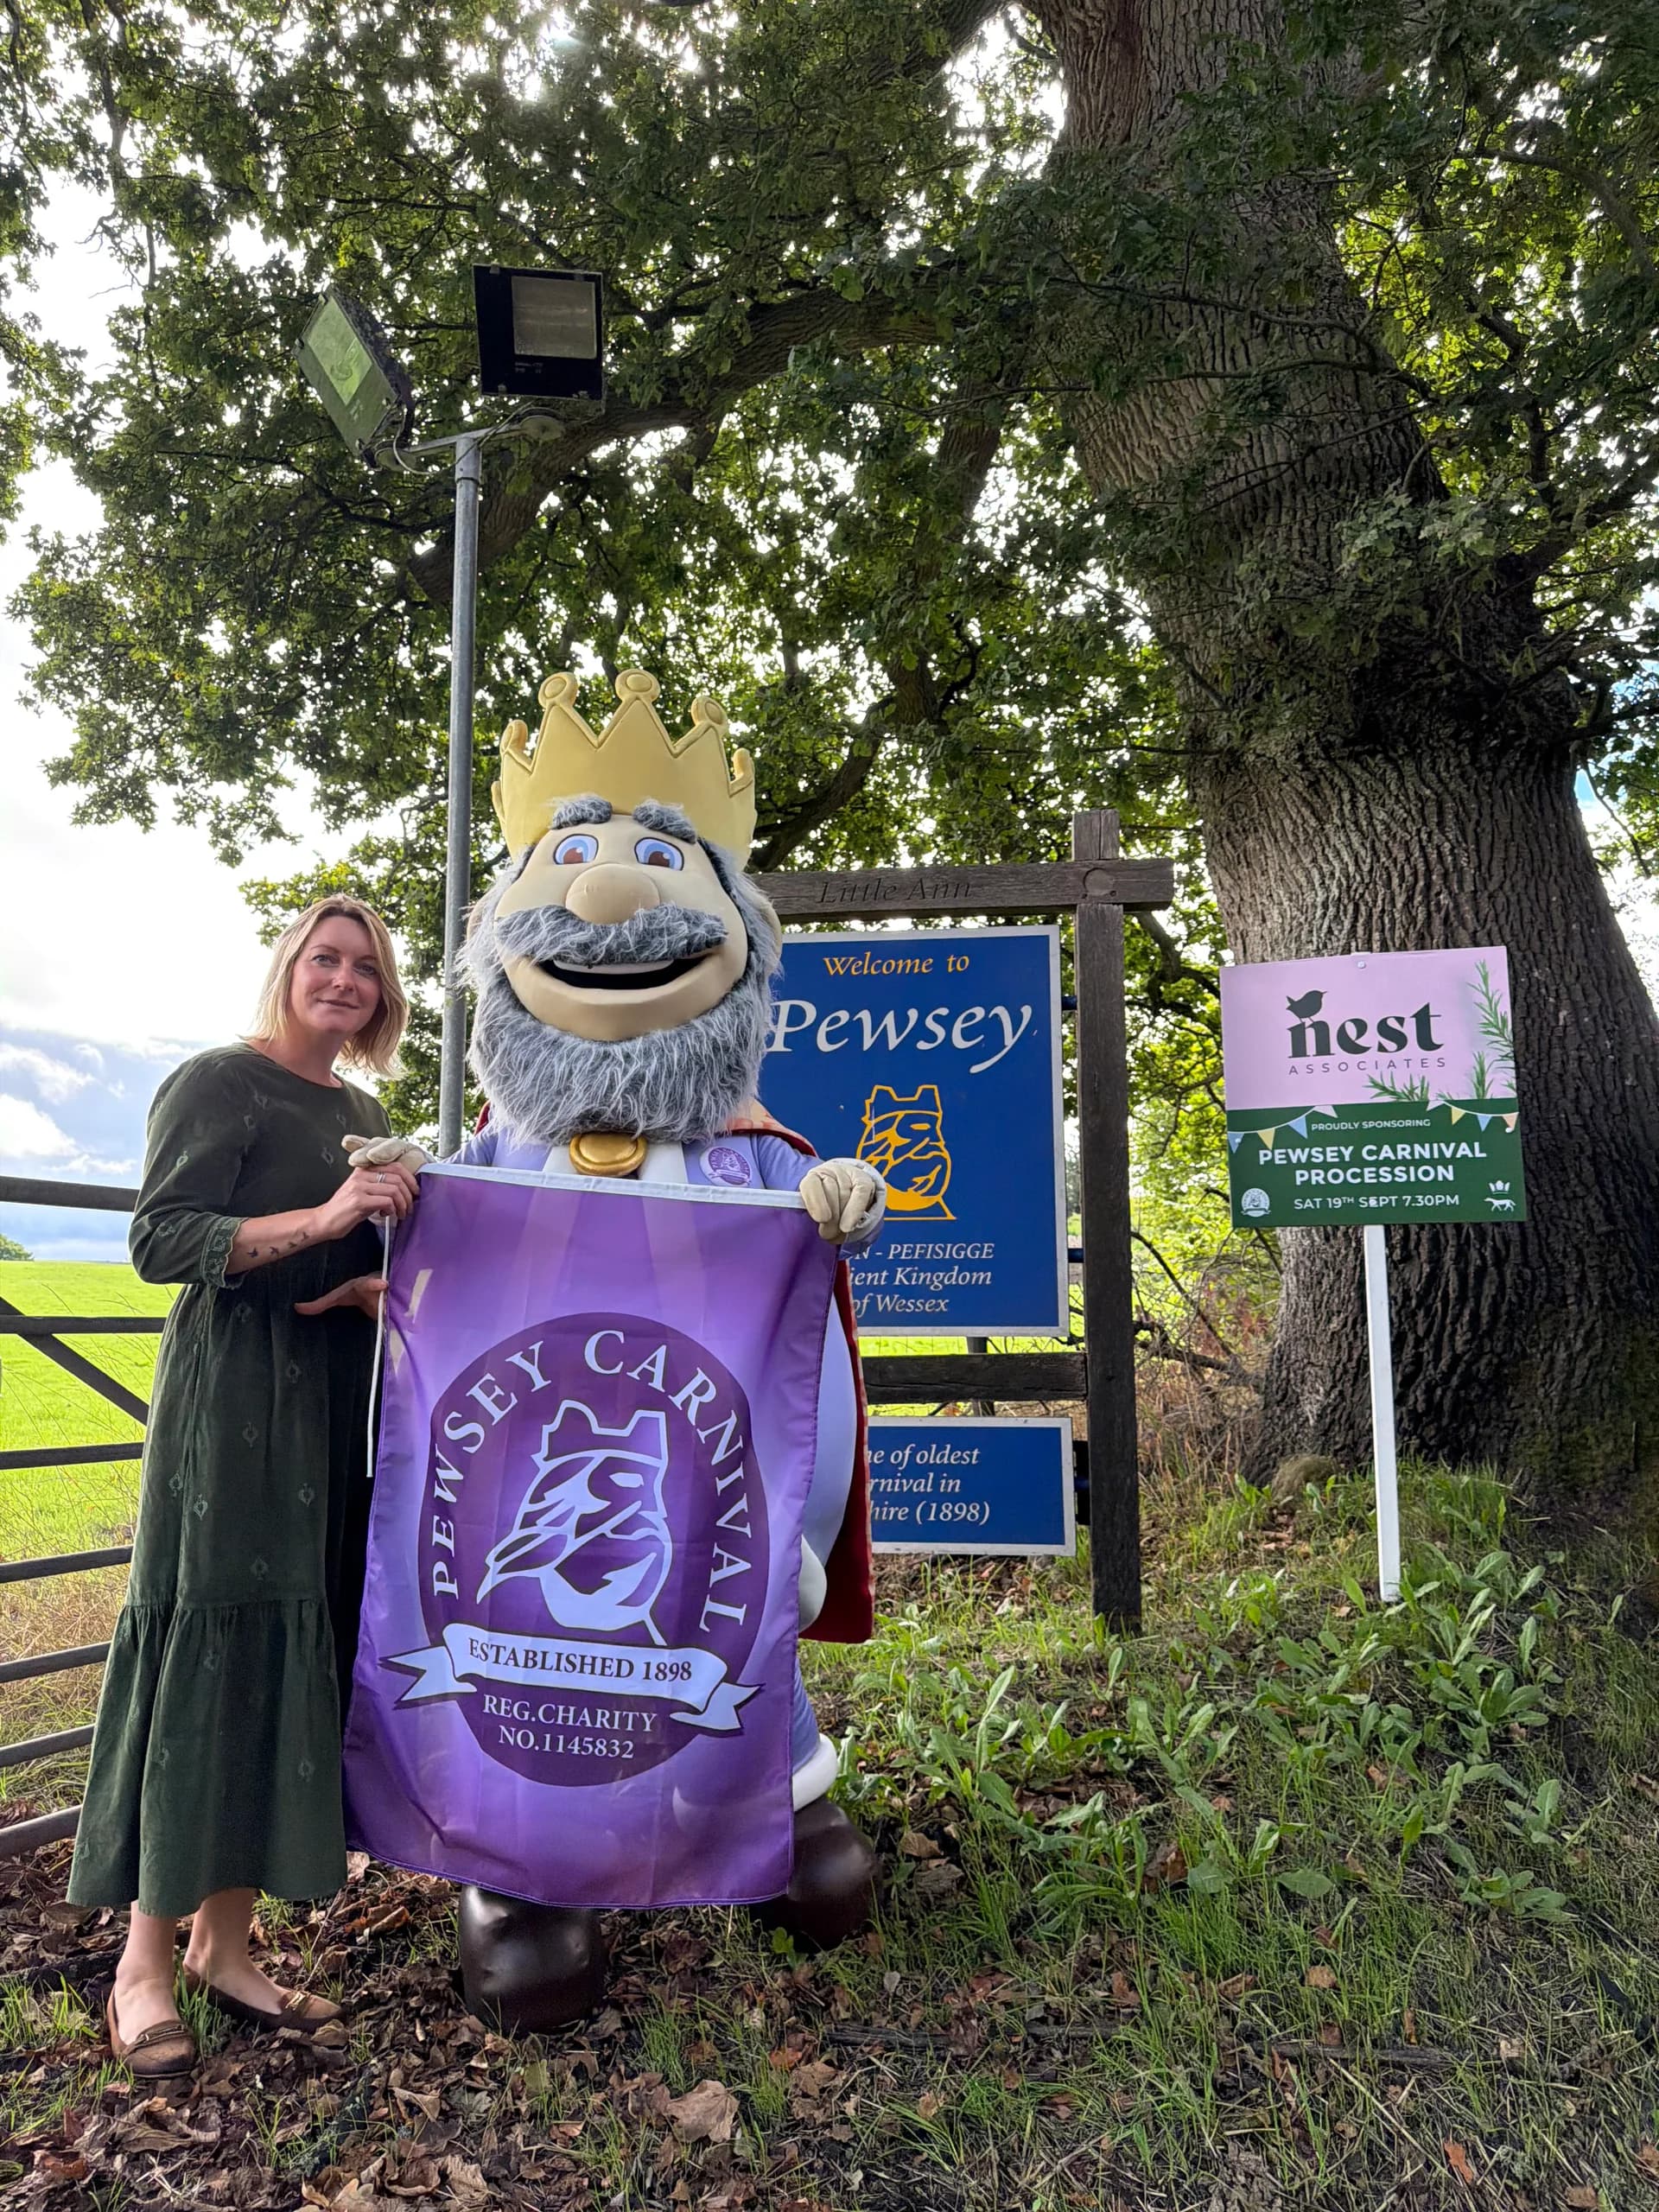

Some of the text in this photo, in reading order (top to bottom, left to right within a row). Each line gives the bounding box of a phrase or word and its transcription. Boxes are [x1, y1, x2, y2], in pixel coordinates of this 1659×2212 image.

[817, 877, 971, 904] Little Ann
[823, 951, 969, 976] Welcome to
[766, 1000, 1032, 1073] Pewsey
[1287, 1001, 1444, 1058] nest
[1288, 1057, 1446, 1076] ASSOCIATES
[1311, 1119, 1431, 1132] PROUDLY SPONSORING
[1259, 1141, 1487, 1165] PEWSEY CARNIVAL
[1295, 1165, 1454, 1185] PROCESSION
[1294, 1198, 1323, 1210] SAT
[1358, 1195, 1398, 1208] SEPT
[1402, 1194, 1459, 1207] 7.30PM
[887, 1243, 995, 1260] PEFISIGGE
[849, 1266, 992, 1292] ient Kingdom
[853, 1293, 950, 1319] of Wessex
[432, 1341, 551, 1600] PEWSEY
[890, 1444, 916, 1471] of
[916, 1444, 981, 1465] oldest
[584, 1330, 753, 1633] CARNIVAL
[868, 1471, 962, 1492] rnival in
[869, 1499, 990, 1526] hire (1898)
[468, 1637, 693, 1682] ESTABLISHED 1898
[498, 1726, 634, 1759] NO.1145832
